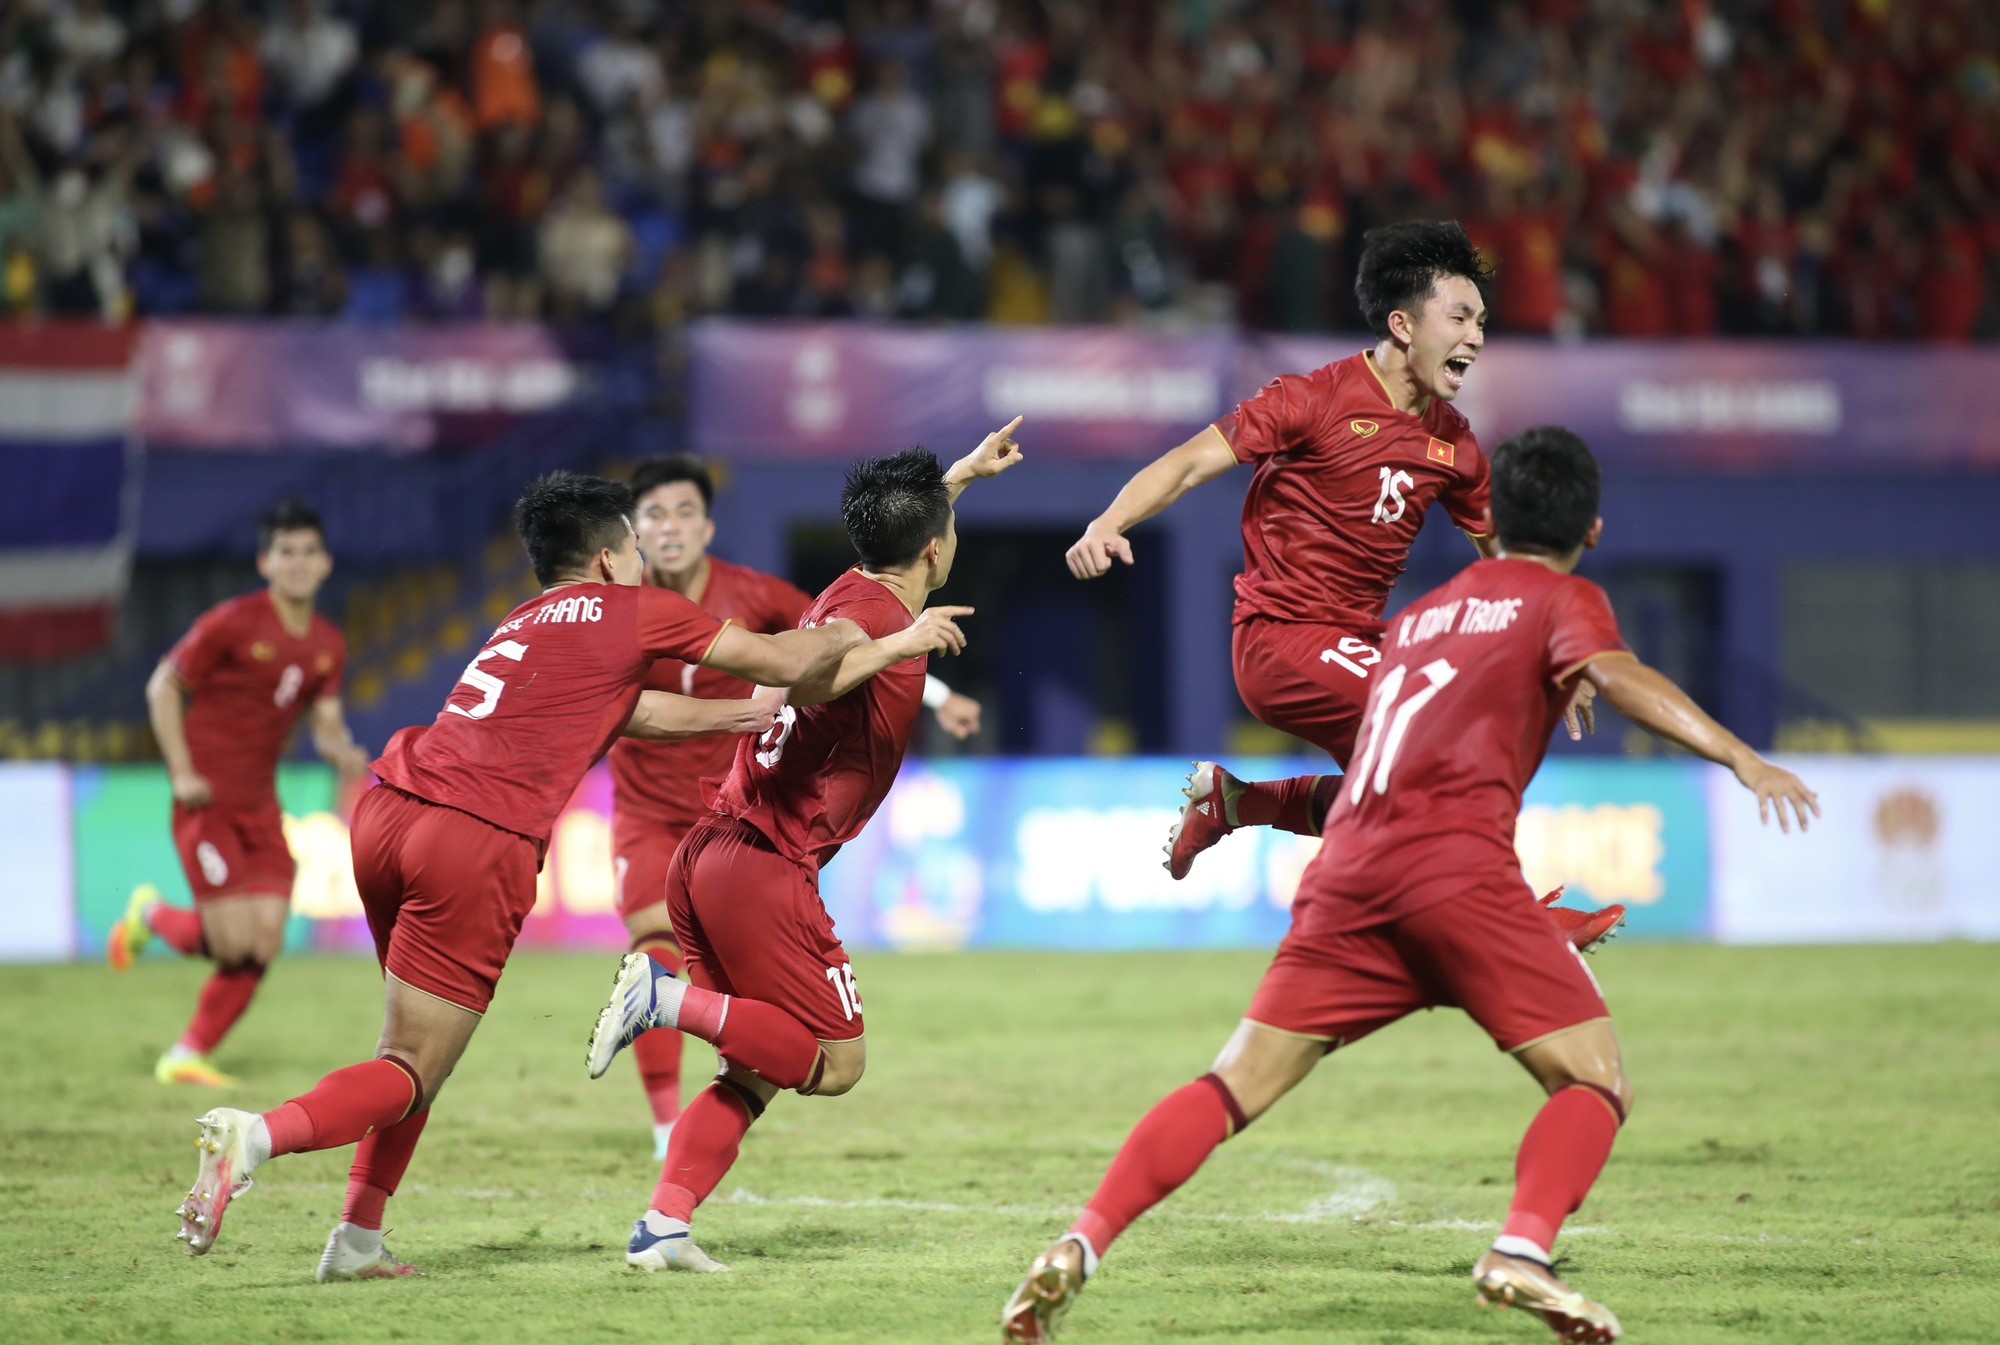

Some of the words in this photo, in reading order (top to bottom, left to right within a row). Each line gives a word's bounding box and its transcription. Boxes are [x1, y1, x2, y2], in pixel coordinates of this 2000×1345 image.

[1371, 466, 1415, 524] 15
[533, 596, 604, 625] THANG
[446, 639, 529, 720] 5
[1319, 637, 1382, 678] 15
[1351, 658, 1459, 806] 17
